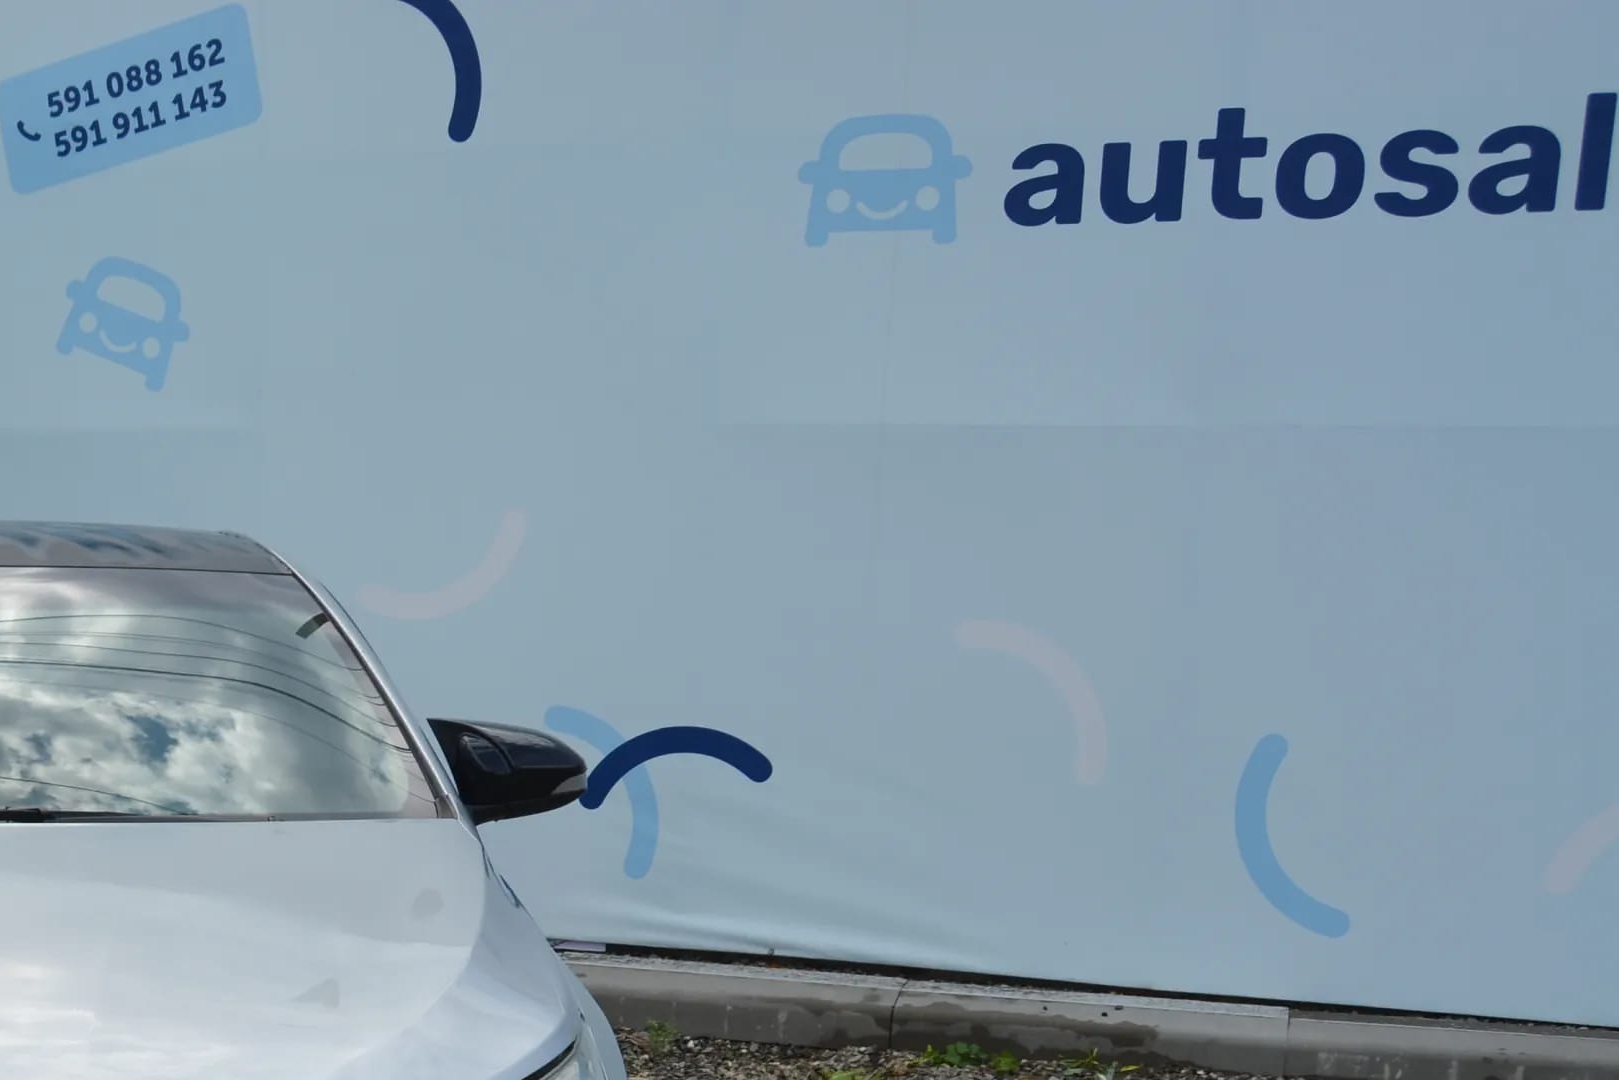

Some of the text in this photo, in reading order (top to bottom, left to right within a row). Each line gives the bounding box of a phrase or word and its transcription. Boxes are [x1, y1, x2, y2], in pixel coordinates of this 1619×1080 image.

[47, 38, 225, 118] 591 088 162
[54, 79, 227, 158] 591 911 143
